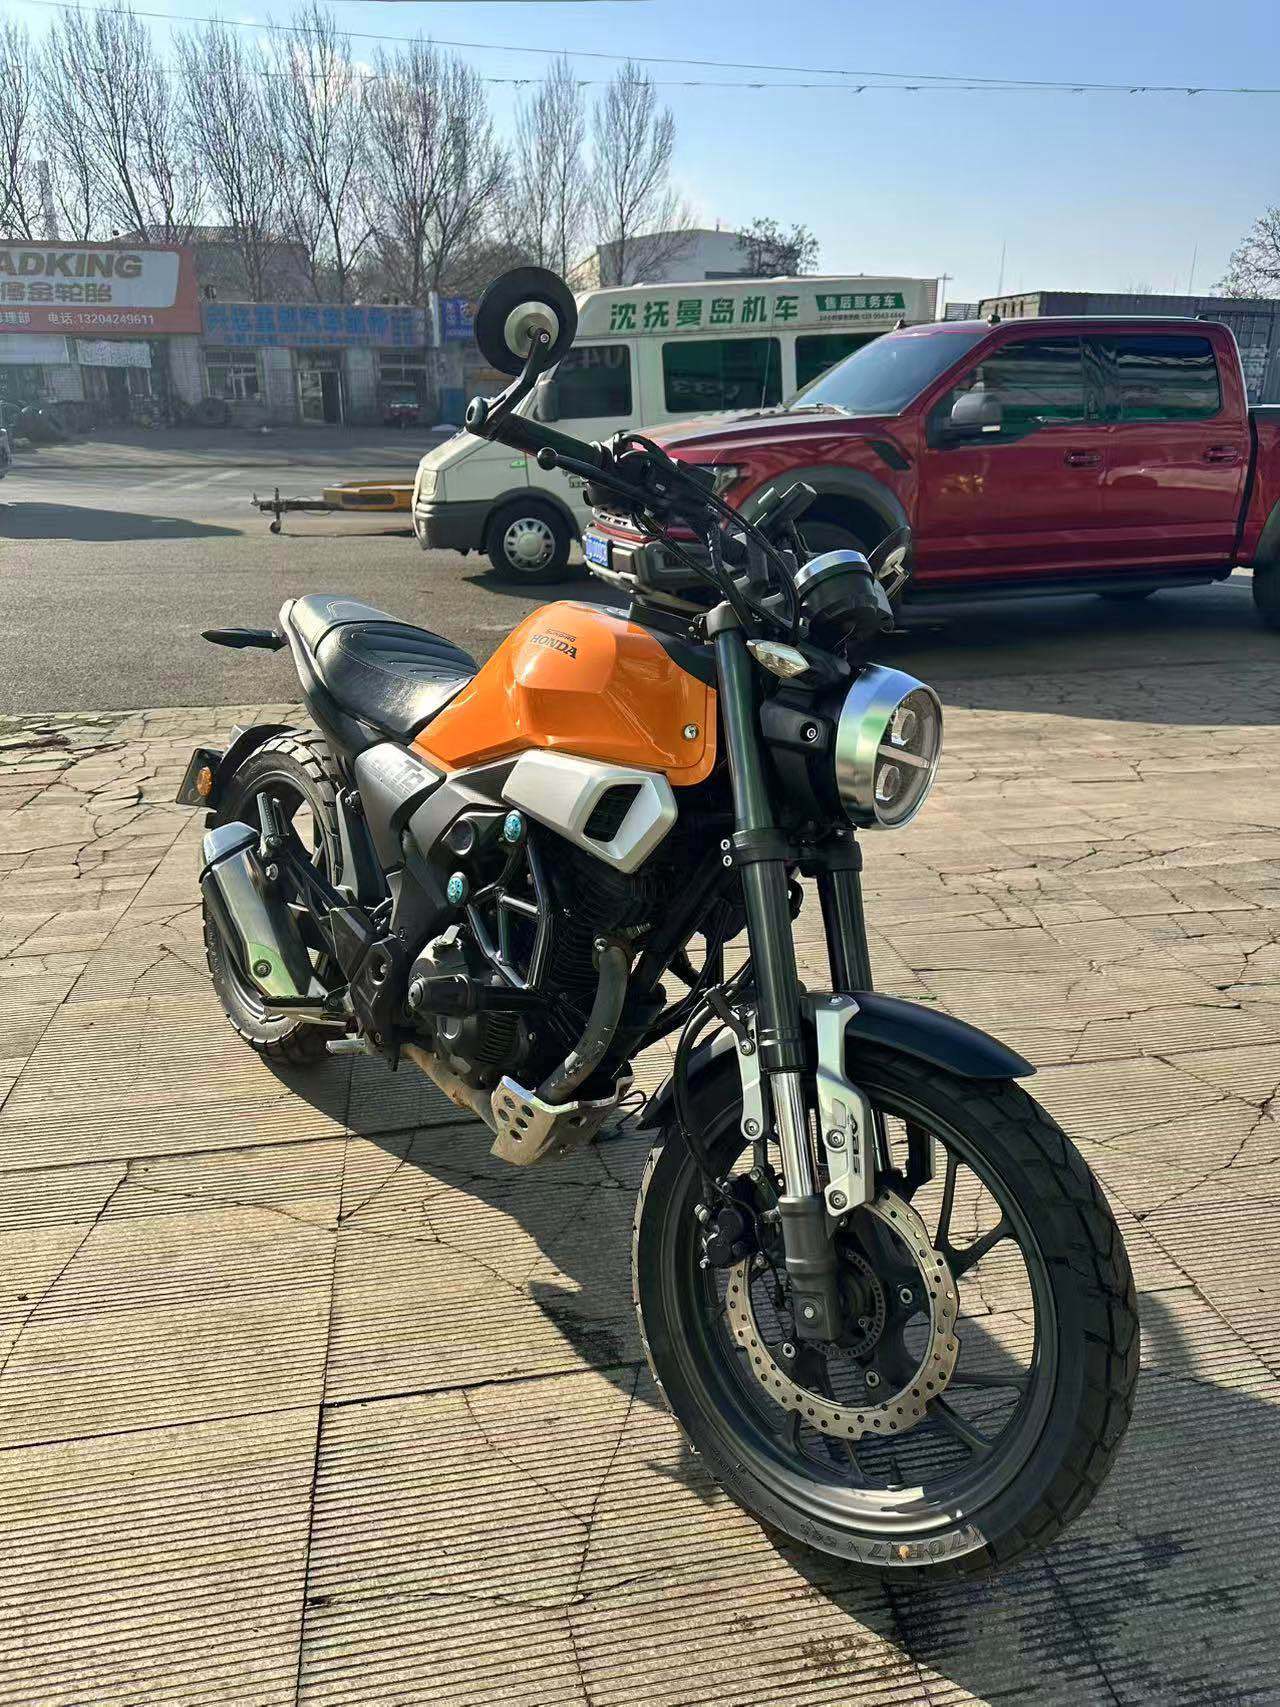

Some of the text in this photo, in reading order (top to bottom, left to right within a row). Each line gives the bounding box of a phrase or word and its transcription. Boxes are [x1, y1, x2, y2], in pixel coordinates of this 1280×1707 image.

[0, 311, 31, 326] 理部
[609, 295, 801, 331] 沈抚曼岛机车
[529, 634, 578, 659] HONDA
